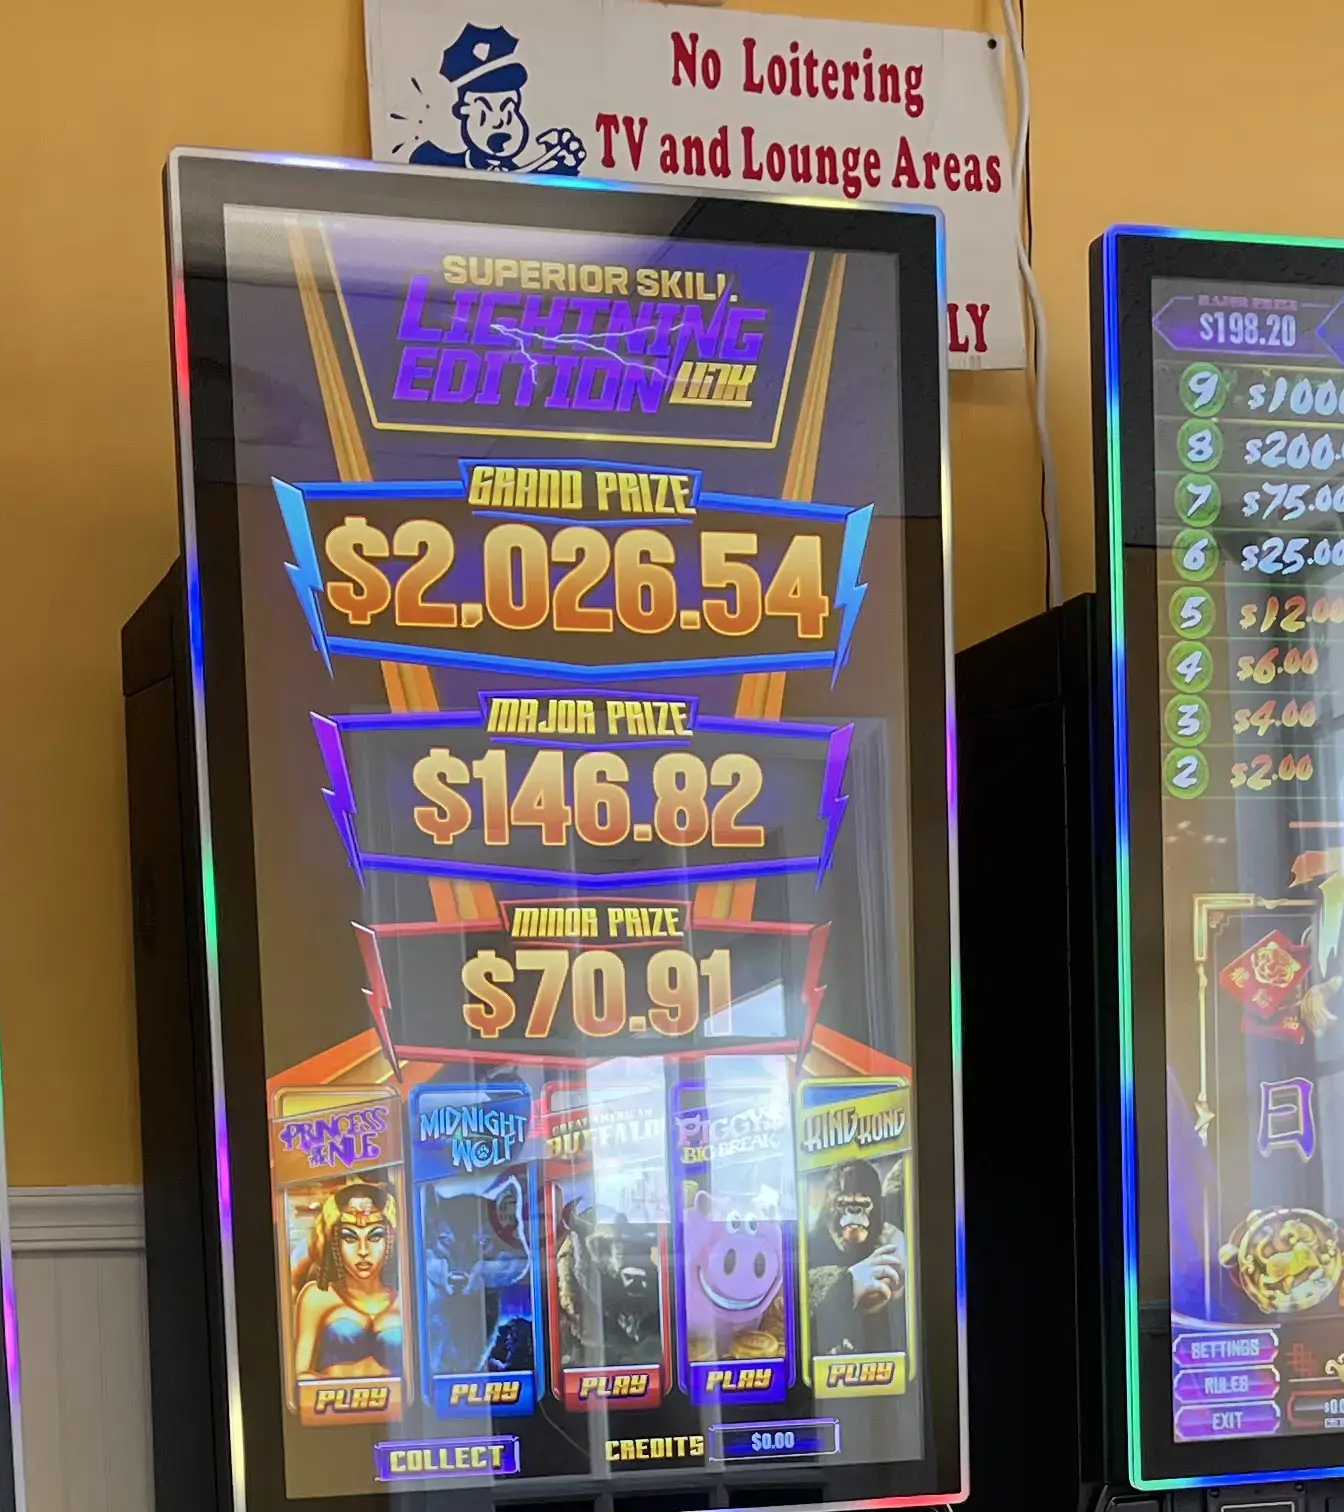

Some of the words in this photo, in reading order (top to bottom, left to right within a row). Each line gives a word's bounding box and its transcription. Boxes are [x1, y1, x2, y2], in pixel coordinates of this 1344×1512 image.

[670, 31, 722, 90] No
[742, 37, 924, 118] Loitering
[596, 112, 648, 172] TV
[660, 125, 731, 179] and
[740, 126, 882, 200] Lounge
[891, 136, 1002, 194] Areas
[442, 255, 628, 297] SUPERIOR
[396, 274, 767, 361] LIGHTNING
[1199, 311, 1297, 348] $198.20
[392, 346, 670, 414] EDITION
[1188, 371, 1218, 409] 9
[1187, 429, 1213, 462] 8
[468, 466, 584, 511] GRAND
[596, 471, 697, 514] PRIZE
[1187, 482, 1212, 517] 7
[1183, 538, 1209, 571] 6
[324, 516, 829, 639] $2,026.54
[1180, 596, 1207, 629] 5
[1176, 650, 1203, 683] 4
[1236, 646, 1319, 684] $6.00
[487, 698, 595, 736] MAJOR
[606, 700, 694, 737] PRIZE
[1177, 704, 1200, 736] 3
[1233, 699, 1317, 737] $4.00
[1172, 755, 1198, 788] 2
[1230, 753, 1313, 790] $2.00
[412, 748, 765, 848] $146.82
[511, 907, 599, 938] MINOR
[608, 907, 685, 938] PRIZE
[461, 948, 733, 1039] $70.91
[419, 1105, 528, 1143] MIDNIGHT
[803, 1105, 858, 1152] KING
[856, 1107, 906, 1147] KONG
[451, 1134, 517, 1173] WOLF
[1191, 1338, 1260, 1359] SETTINGS
[578, 1372, 649, 1399] PLAY
[705, 1366, 772, 1392] PLAY
[826, 1360, 896, 1387] PLAY
[1204, 1375, 1249, 1395] RULES
[315, 1384, 390, 1413] PLAY
[450, 1380, 522, 1406] PLAY
[1212, 1411, 1243, 1431] EXIT
[388, 1443, 505, 1474] COLLECT
[605, 1433, 705, 1462] CREDITS
[750, 1430, 796, 1451] $0.00
